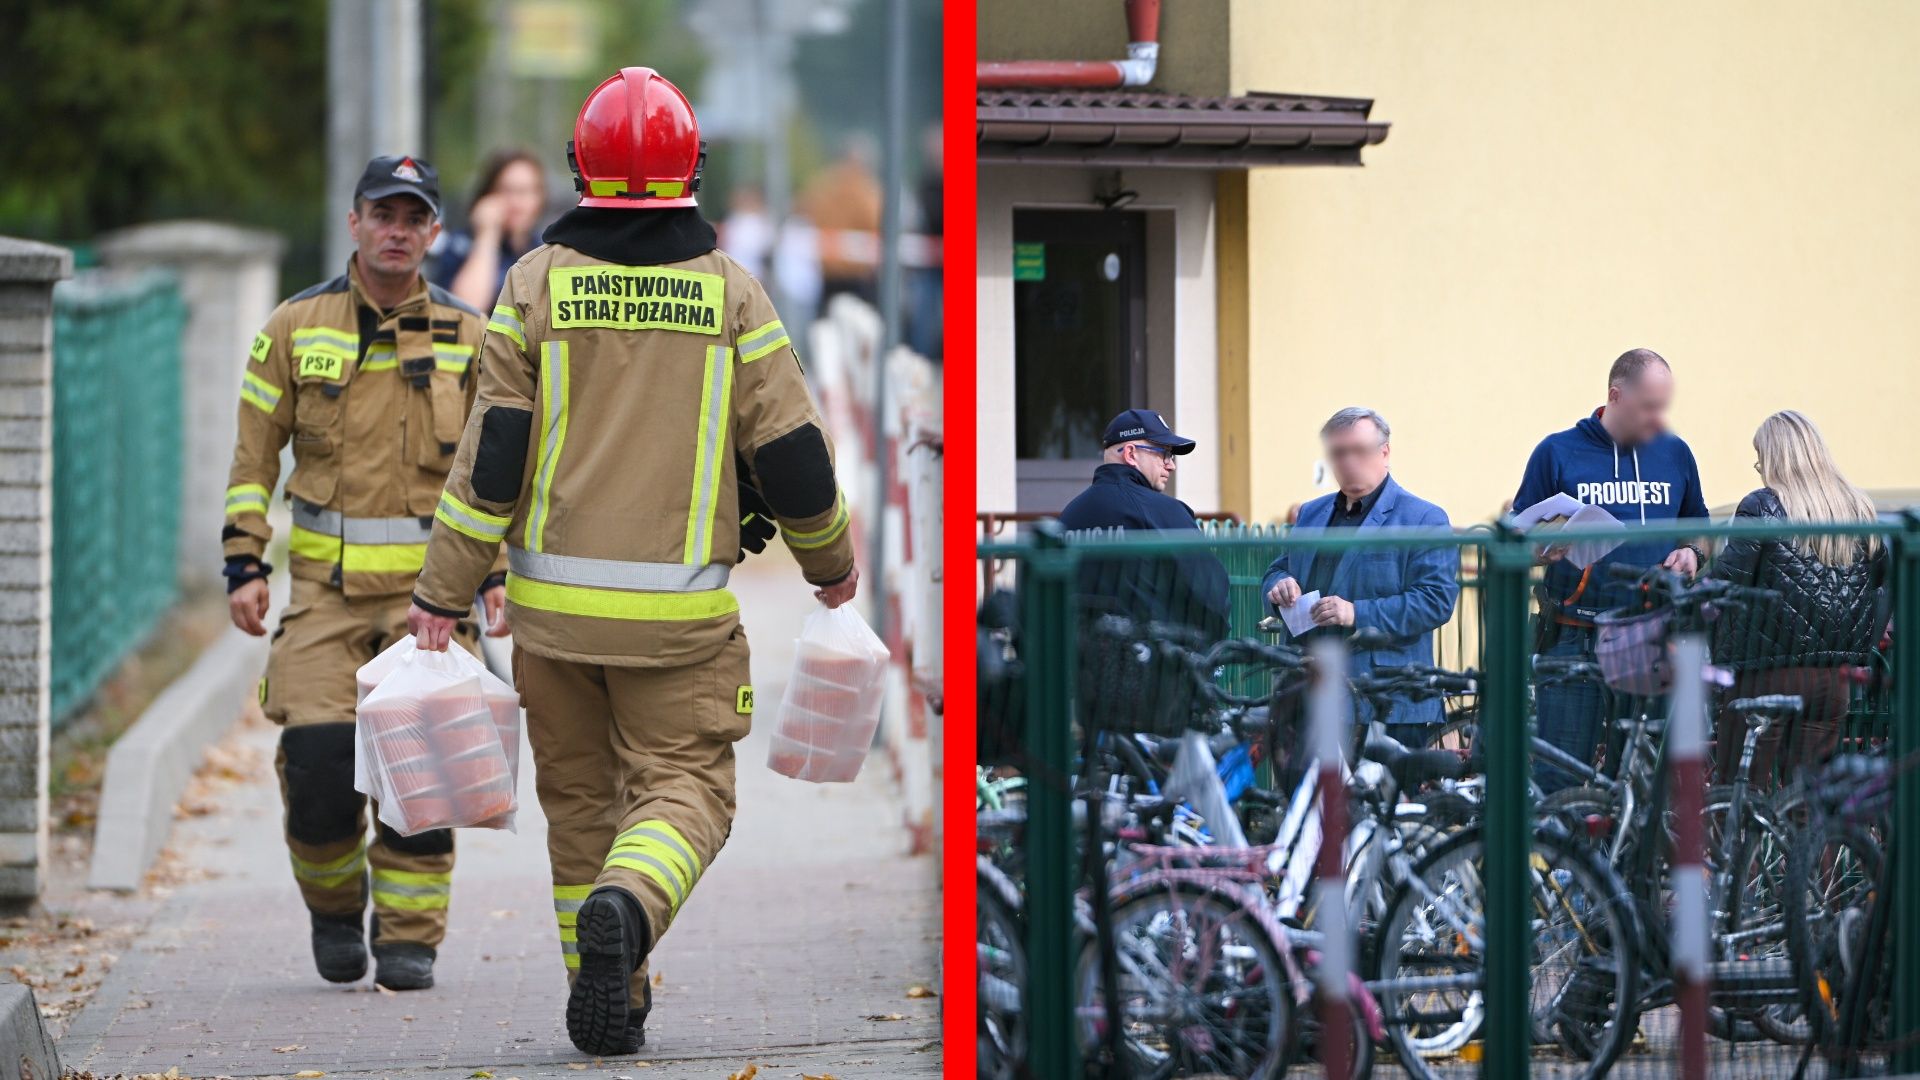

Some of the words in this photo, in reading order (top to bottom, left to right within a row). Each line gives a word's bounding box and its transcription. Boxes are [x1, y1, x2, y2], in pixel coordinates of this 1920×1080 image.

[571, 270, 703, 301] PAŃSTWOWA
[305, 356, 335, 371] PSP
[1119, 427, 1145, 438] POLICJA
[1577, 481, 1671, 505] PROUDEST
[742, 691, 753, 708] PS
